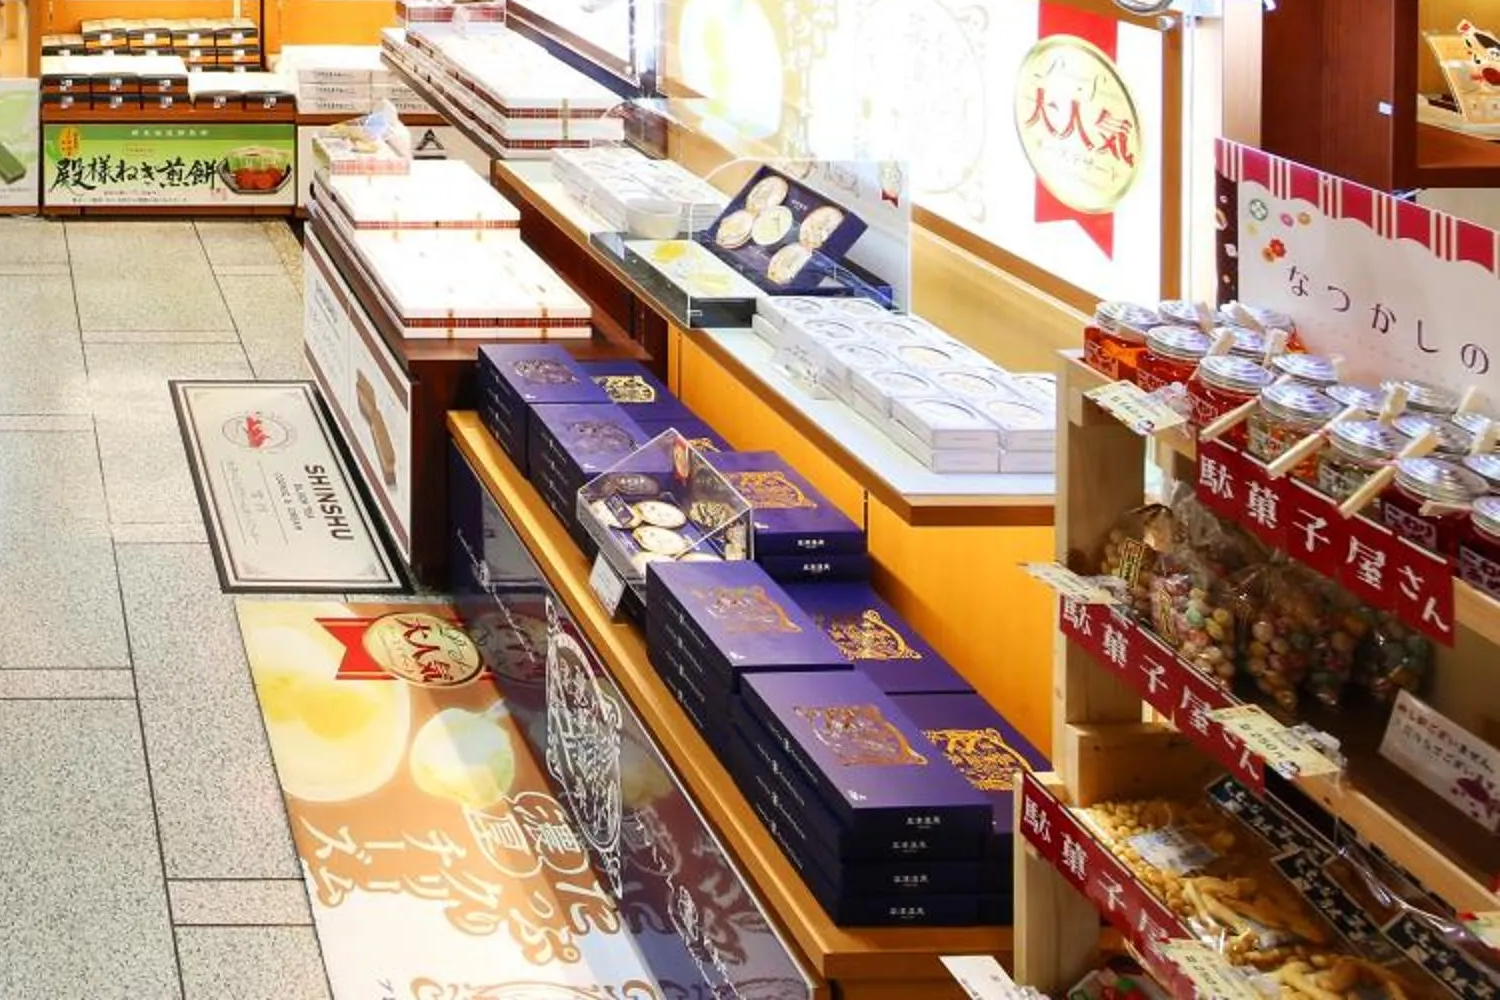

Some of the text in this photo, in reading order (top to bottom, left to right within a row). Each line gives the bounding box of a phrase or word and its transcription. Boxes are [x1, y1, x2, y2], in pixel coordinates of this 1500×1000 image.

[49, 154, 218, 192] 殿様ねぎ煎餅
[1287, 266, 1489, 375] なつかしの
[304, 464, 355, 540] SHINSHU
[1200, 455, 1452, 635] 駄菓子屋さん
[400, 613, 454, 684] 大人気
[300, 815, 467, 867] チーズ
[468, 801, 581, 856] 濃厚
[314, 864, 503, 909] クリーム
[448, 881, 619, 964] たっぷり
